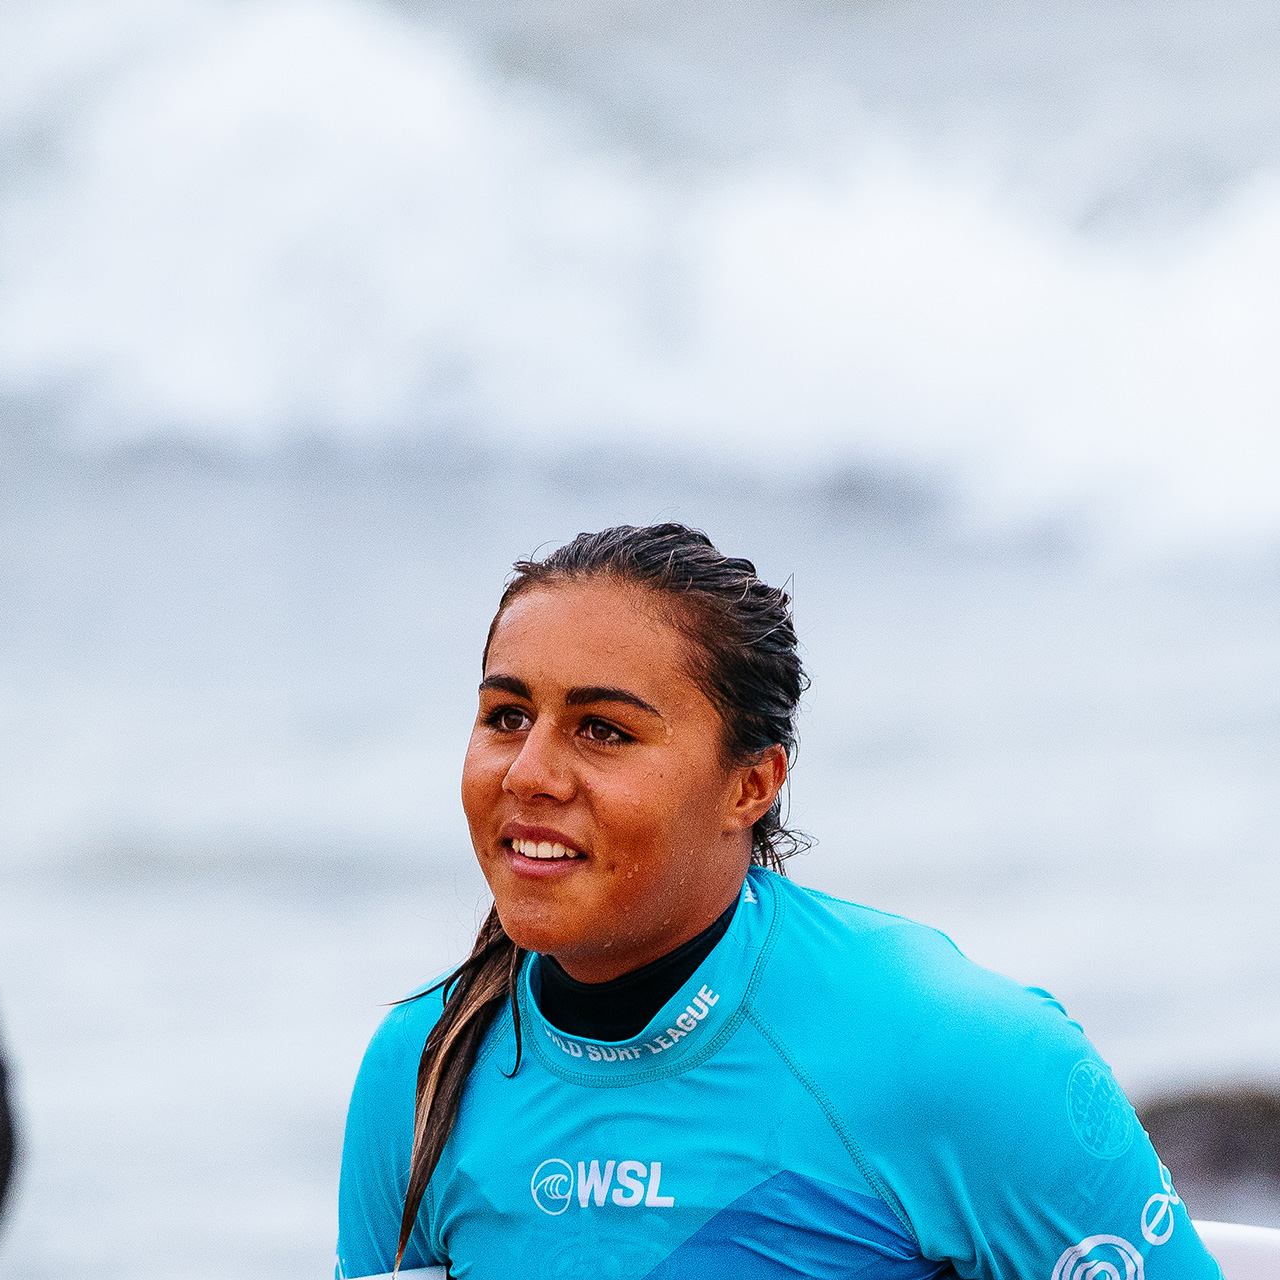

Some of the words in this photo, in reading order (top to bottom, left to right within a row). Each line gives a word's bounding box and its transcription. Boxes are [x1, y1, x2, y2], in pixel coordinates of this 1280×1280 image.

[586, 1045, 641, 1061] SURF
[644, 984, 720, 1054] LEAGUE
[577, 1160, 675, 1208] WSL
